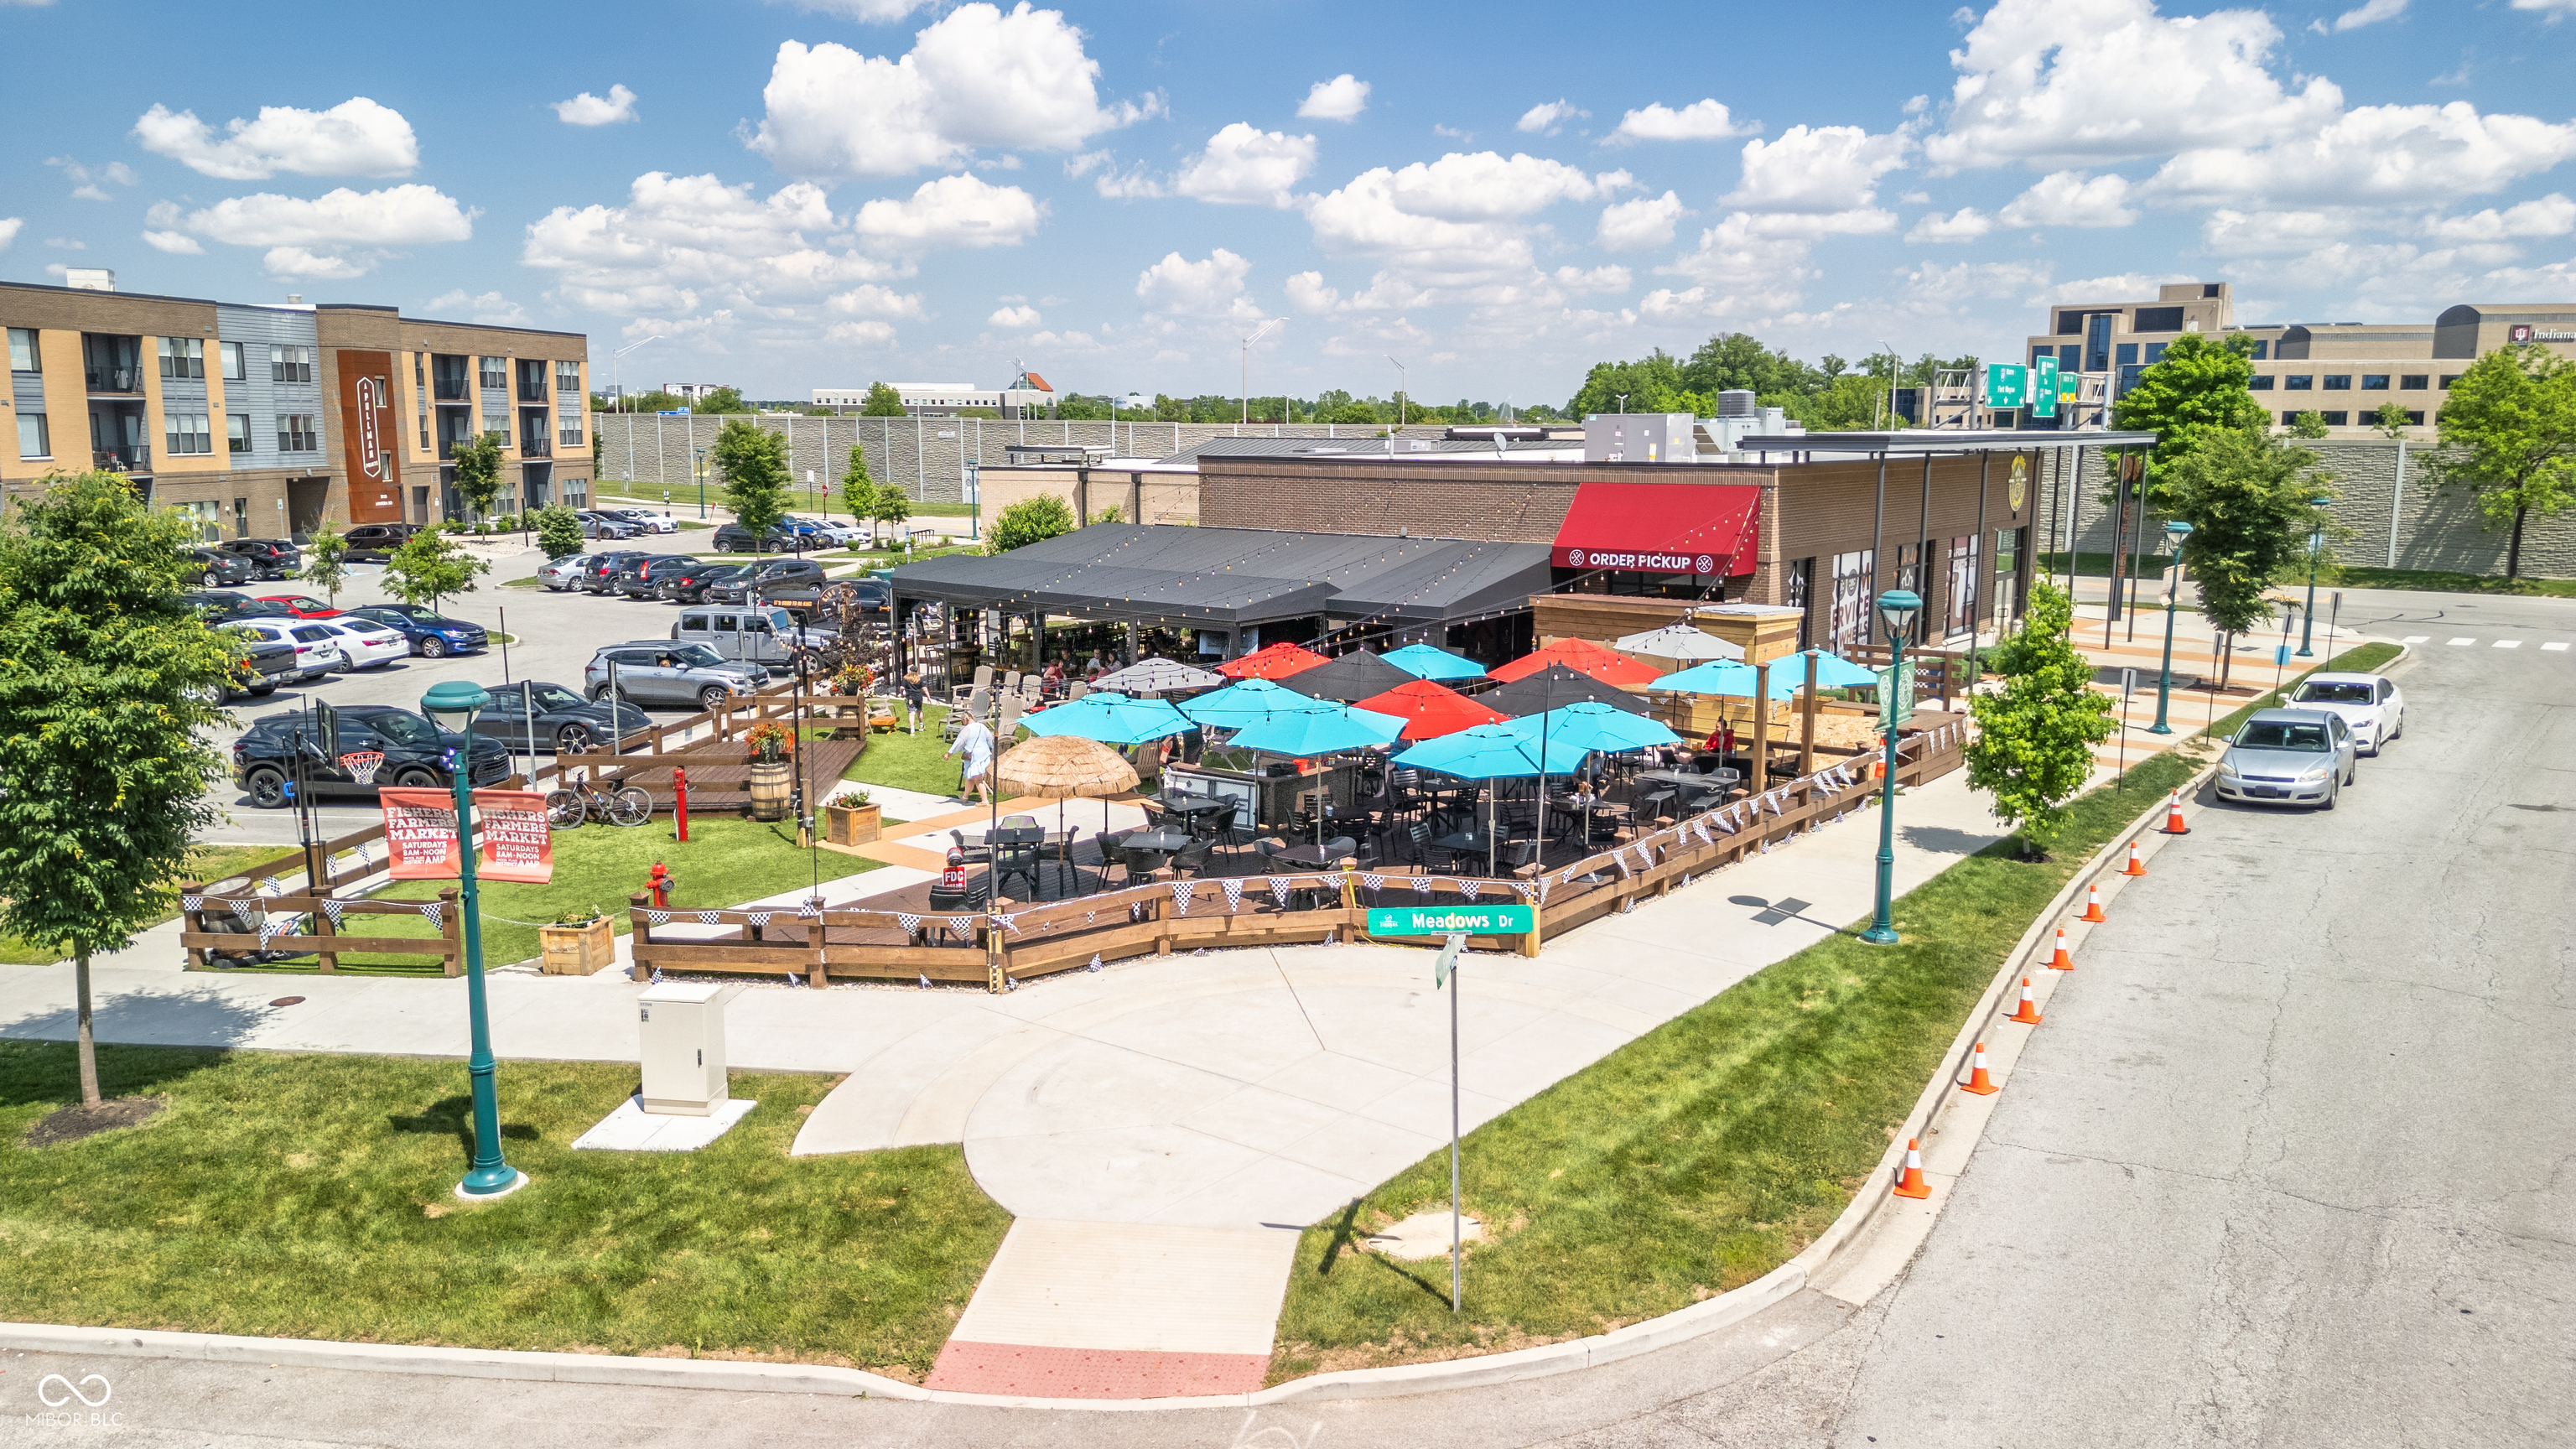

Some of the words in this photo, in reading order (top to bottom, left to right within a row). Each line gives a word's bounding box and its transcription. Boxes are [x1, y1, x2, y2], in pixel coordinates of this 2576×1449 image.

[2534, 328, 2576, 339] Indiana
[1589, 553, 1635, 567] ORDER
[1638, 554, 1690, 569] PICKUP
[386, 807, 453, 818] FISHERS
[480, 808, 546, 822] FISHERS
[389, 828, 458, 840] MARKET
[485, 829, 548, 844] MARKET
[496, 843, 539, 853] SATURDAYS
[424, 855, 446, 865] AMP
[517, 860, 540, 868] AMP
[945, 870, 963, 882] FDC
[1412, 911, 1490, 928] Meadows
[1498, 914, 1514, 927] Dr
